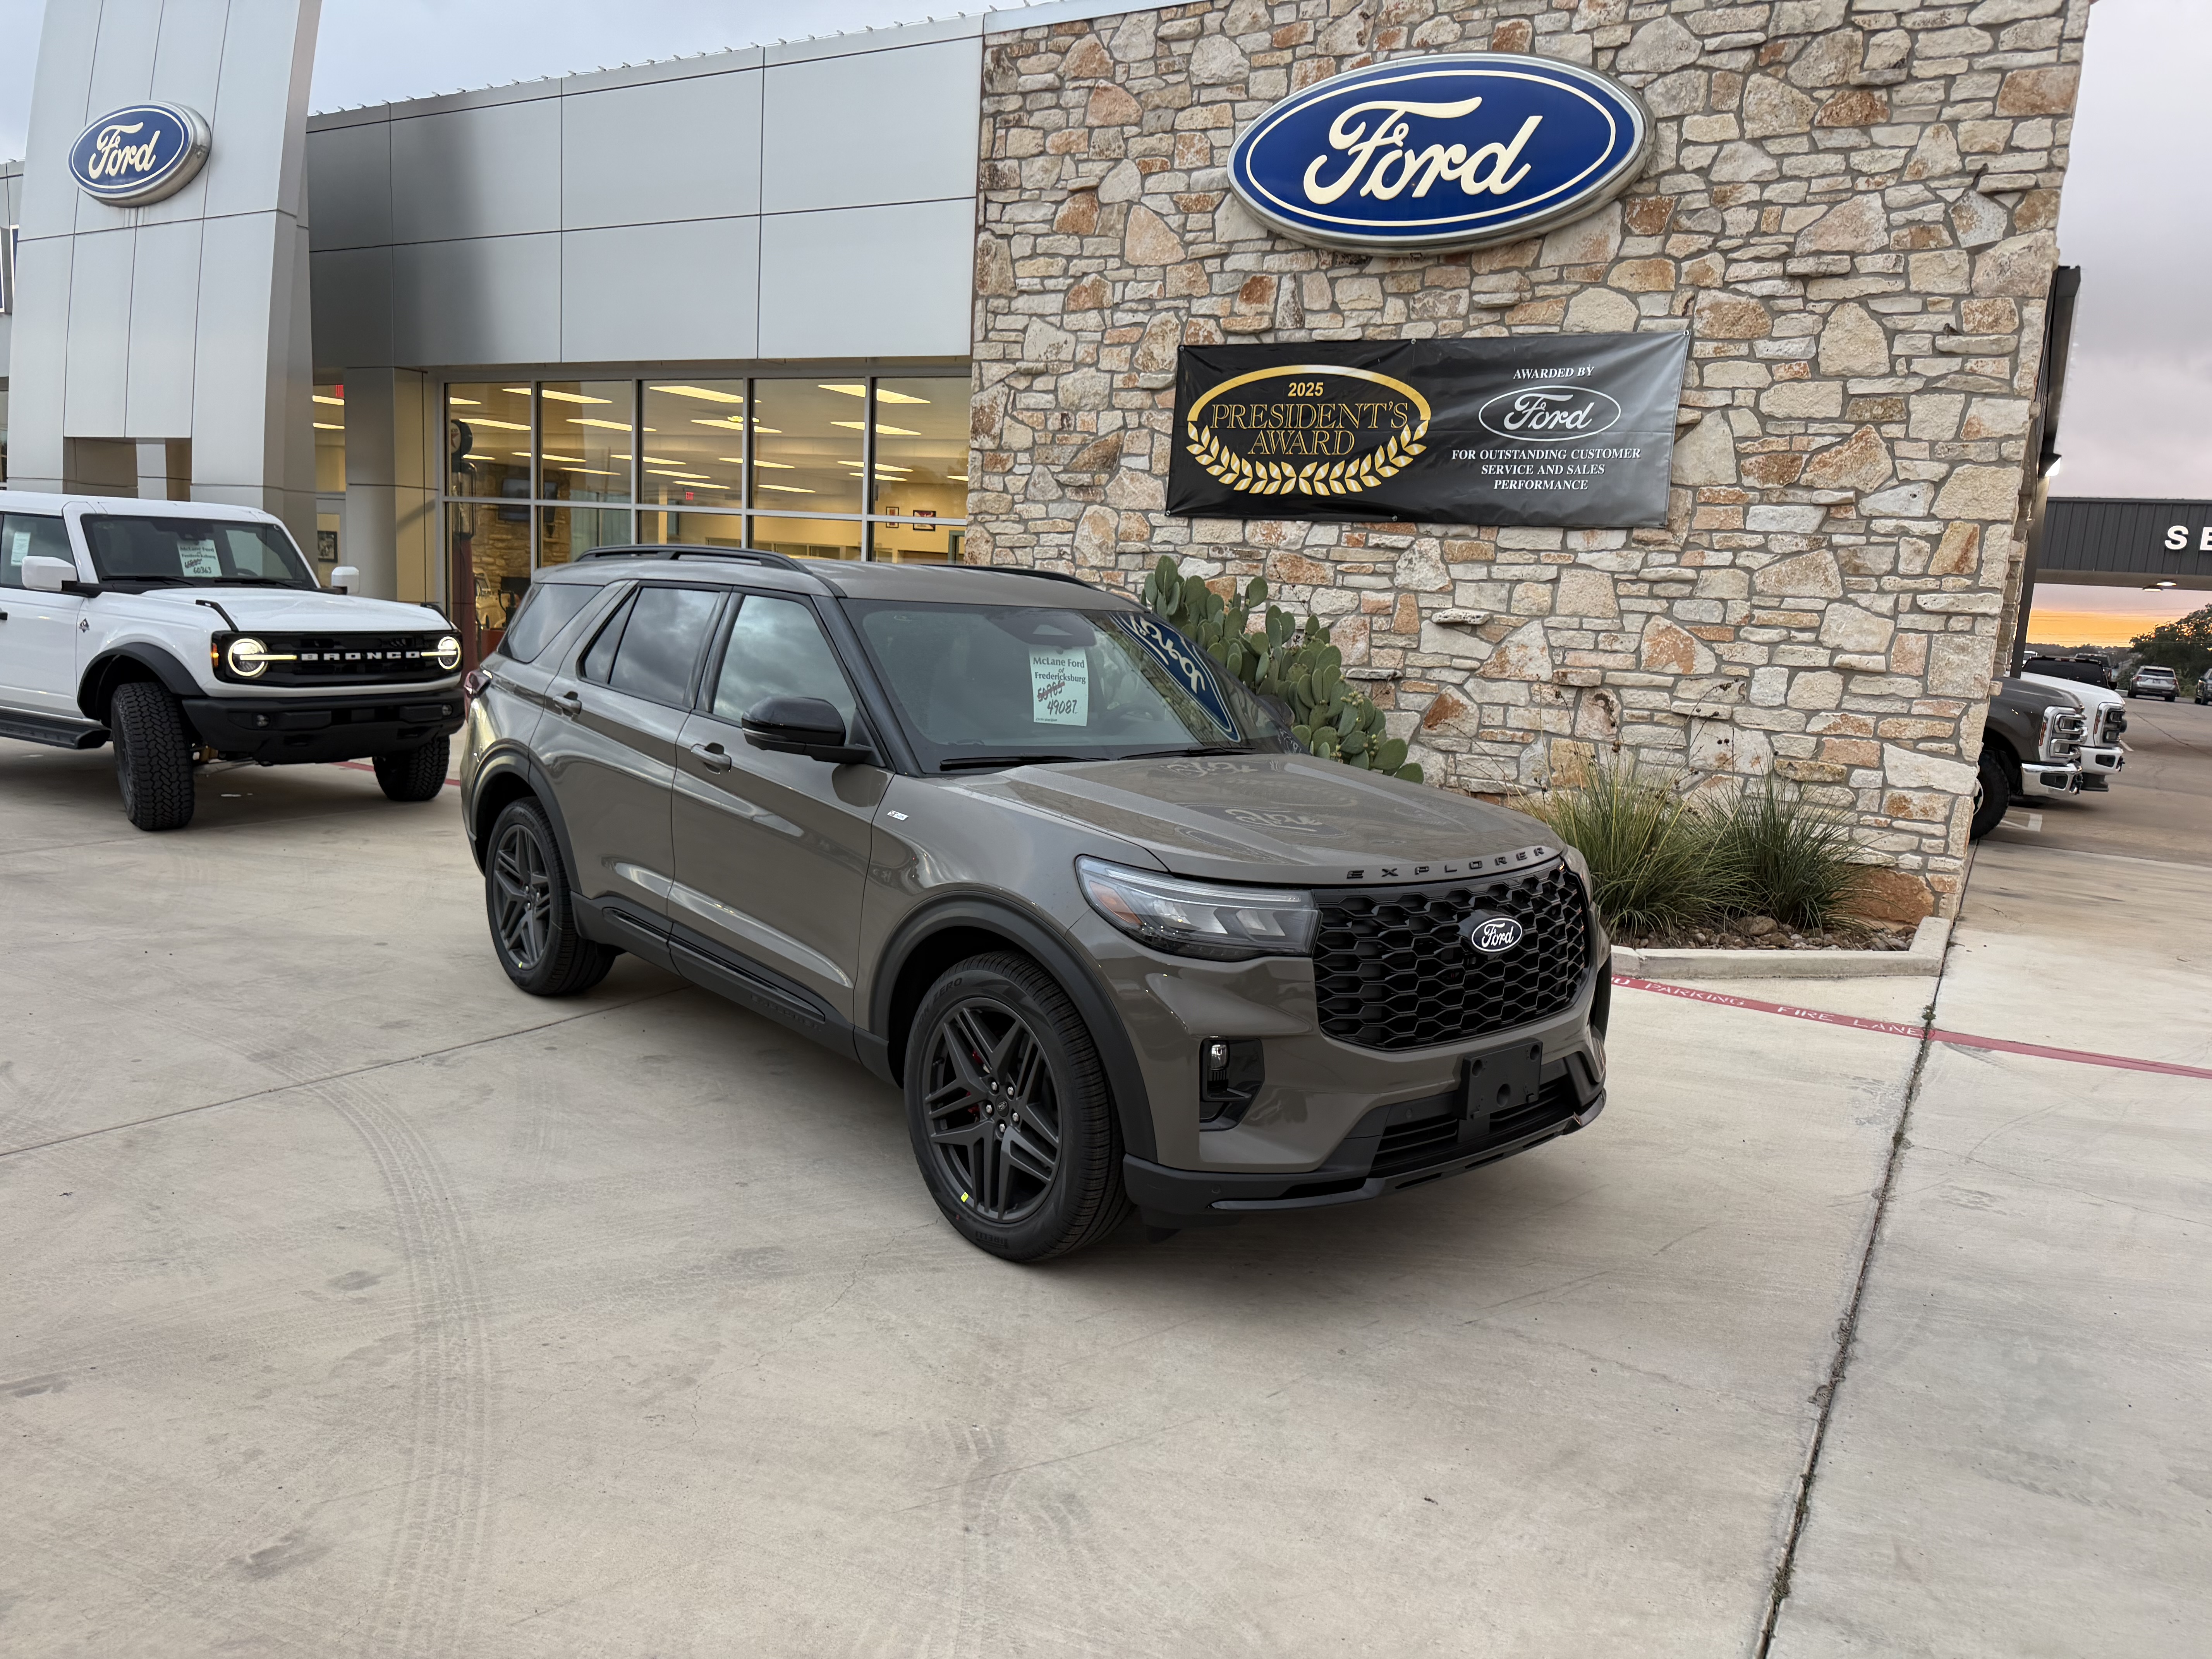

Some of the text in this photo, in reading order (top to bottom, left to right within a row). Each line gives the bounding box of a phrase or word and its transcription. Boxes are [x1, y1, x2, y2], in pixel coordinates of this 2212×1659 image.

[88, 122, 160, 179] Ford
[1303, 96, 1543, 205] Ford
[1513, 366, 1595, 379] AWARDED BY
[1288, 382, 1324, 397] 2025
[1210, 400, 1408, 429] PRESIDENT'S
[1504, 393, 1595, 430] Ford
[1248, 430, 1355, 455] AWARD
[1451, 448, 1641, 460] FOR OUTSTANDING CUSTOMER
[1481, 464, 1606, 475] SERVICE AND SALES
[1494, 479, 1588, 490] PERFORMANCE
[301, 651, 420, 661] BRONCO
[1033, 657, 1085, 668] McLane Ford
[1035, 672, 1086, 684] Fredericksburg
[1346, 847, 1545, 879] EXPLORER
[1481, 922, 1514, 948] Ford
[933, 977, 963, 1004] ZERO
[1645, 982, 1744, 1005] PARKING
[1777, 1006, 1834, 1022] FIRE
[1853, 1019, 1922, 1036] LANE
